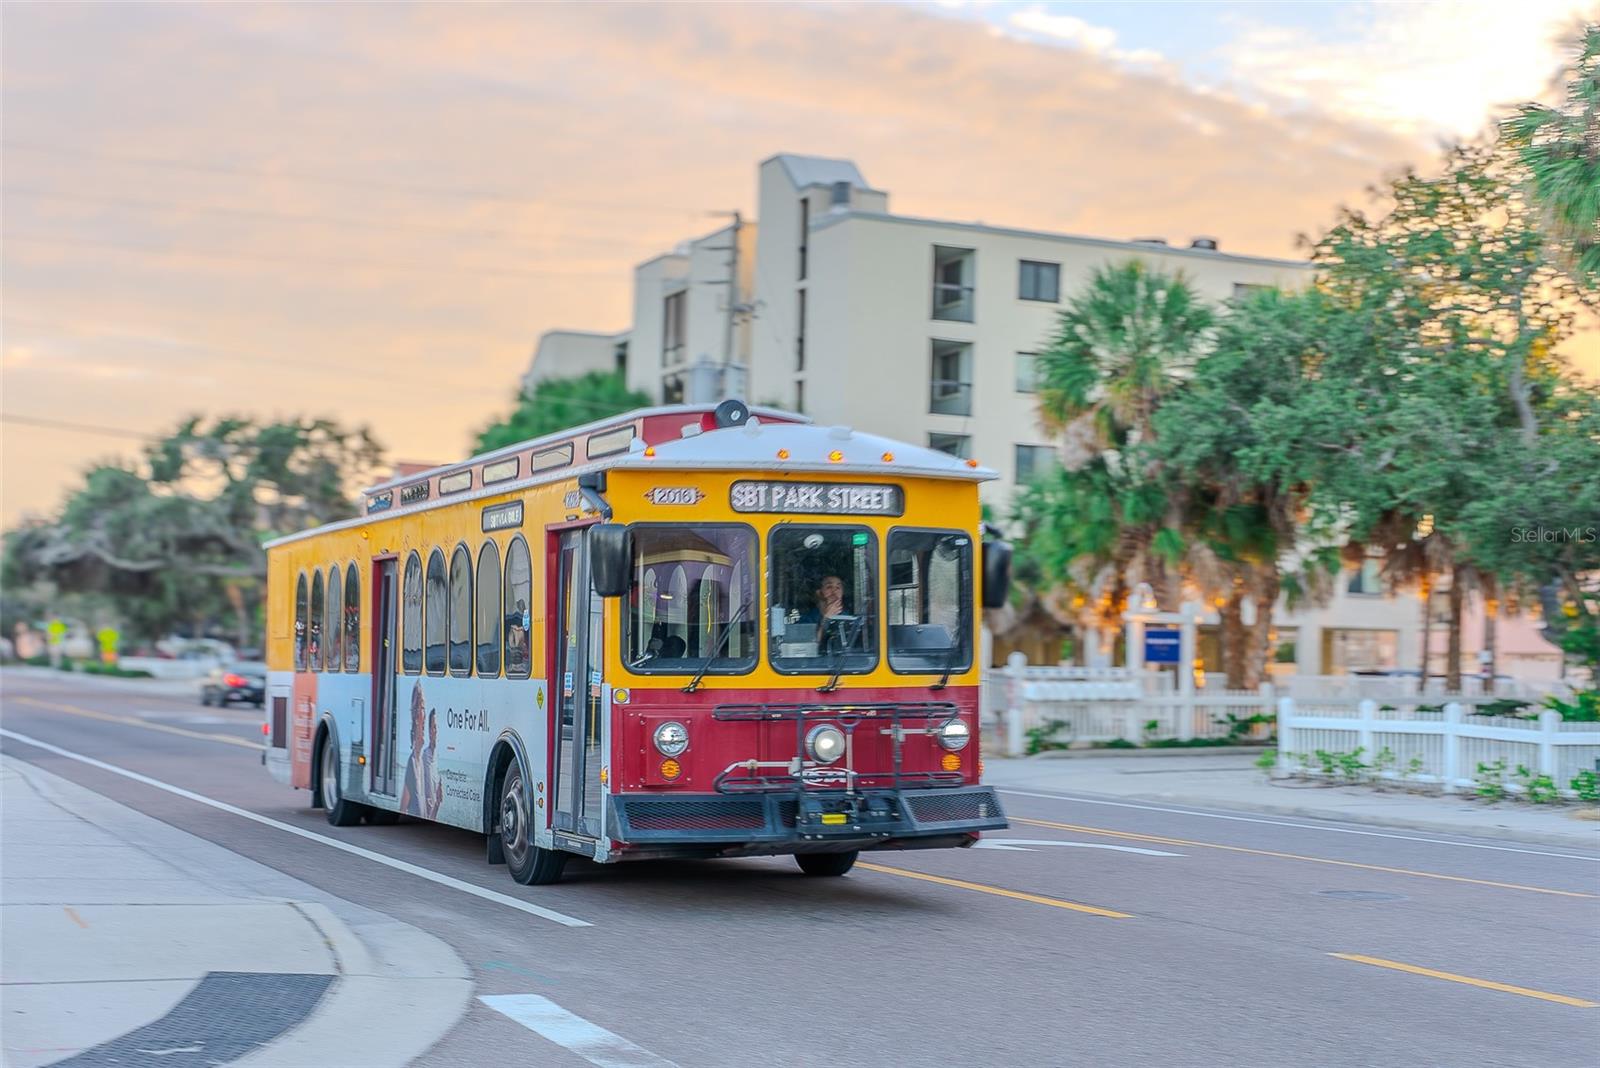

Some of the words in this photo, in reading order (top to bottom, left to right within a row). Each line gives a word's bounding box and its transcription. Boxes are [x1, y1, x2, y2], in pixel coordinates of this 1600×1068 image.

[731, 482, 768, 509] SBT
[771, 485, 824, 509] PARK
[827, 486, 893, 511] STREET
[447, 708, 463, 728] One
[464, 709, 477, 730] For
[477, 709, 490, 732] All.
[446, 784, 469, 800] Connected
